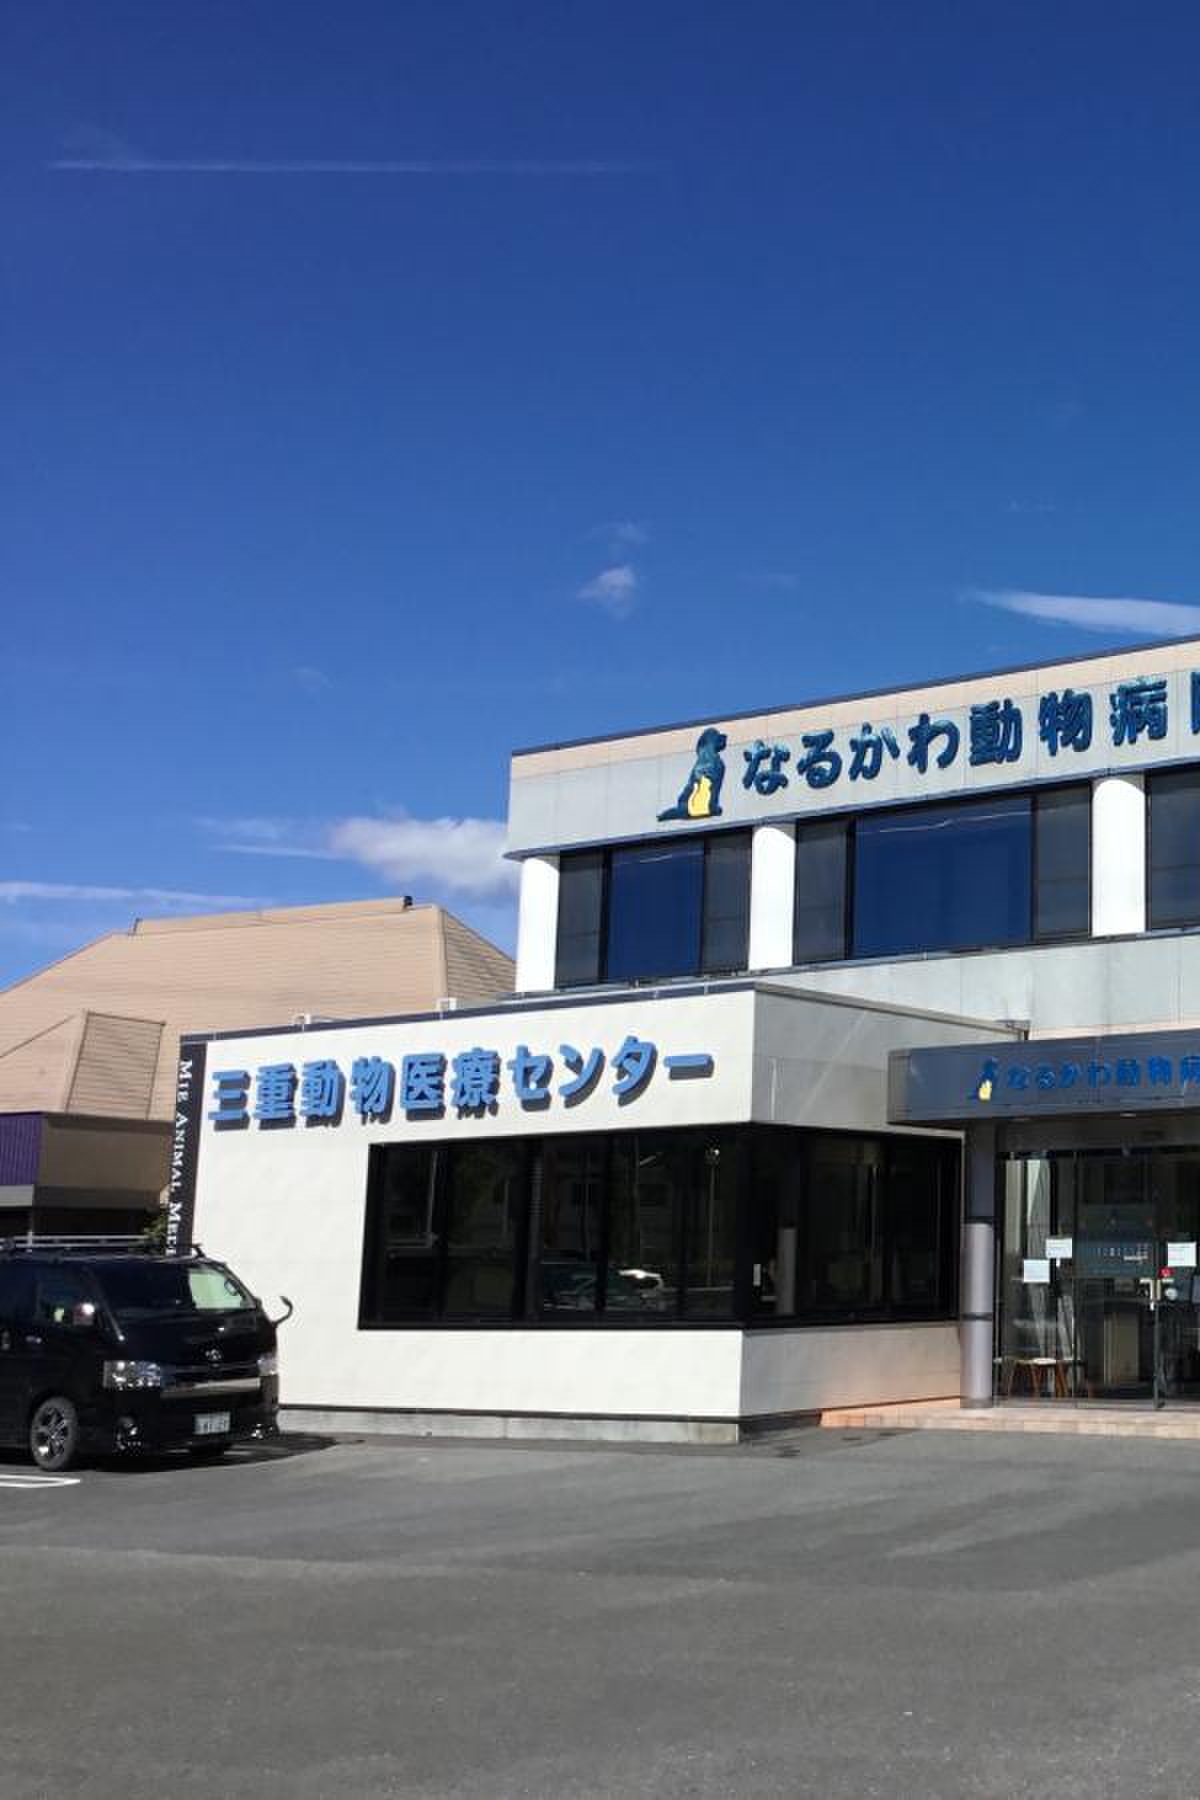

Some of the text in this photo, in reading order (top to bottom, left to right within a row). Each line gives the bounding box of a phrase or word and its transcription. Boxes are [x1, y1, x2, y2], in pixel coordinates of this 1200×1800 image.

[208, 1034, 714, 1124] 三重動物医療センター
